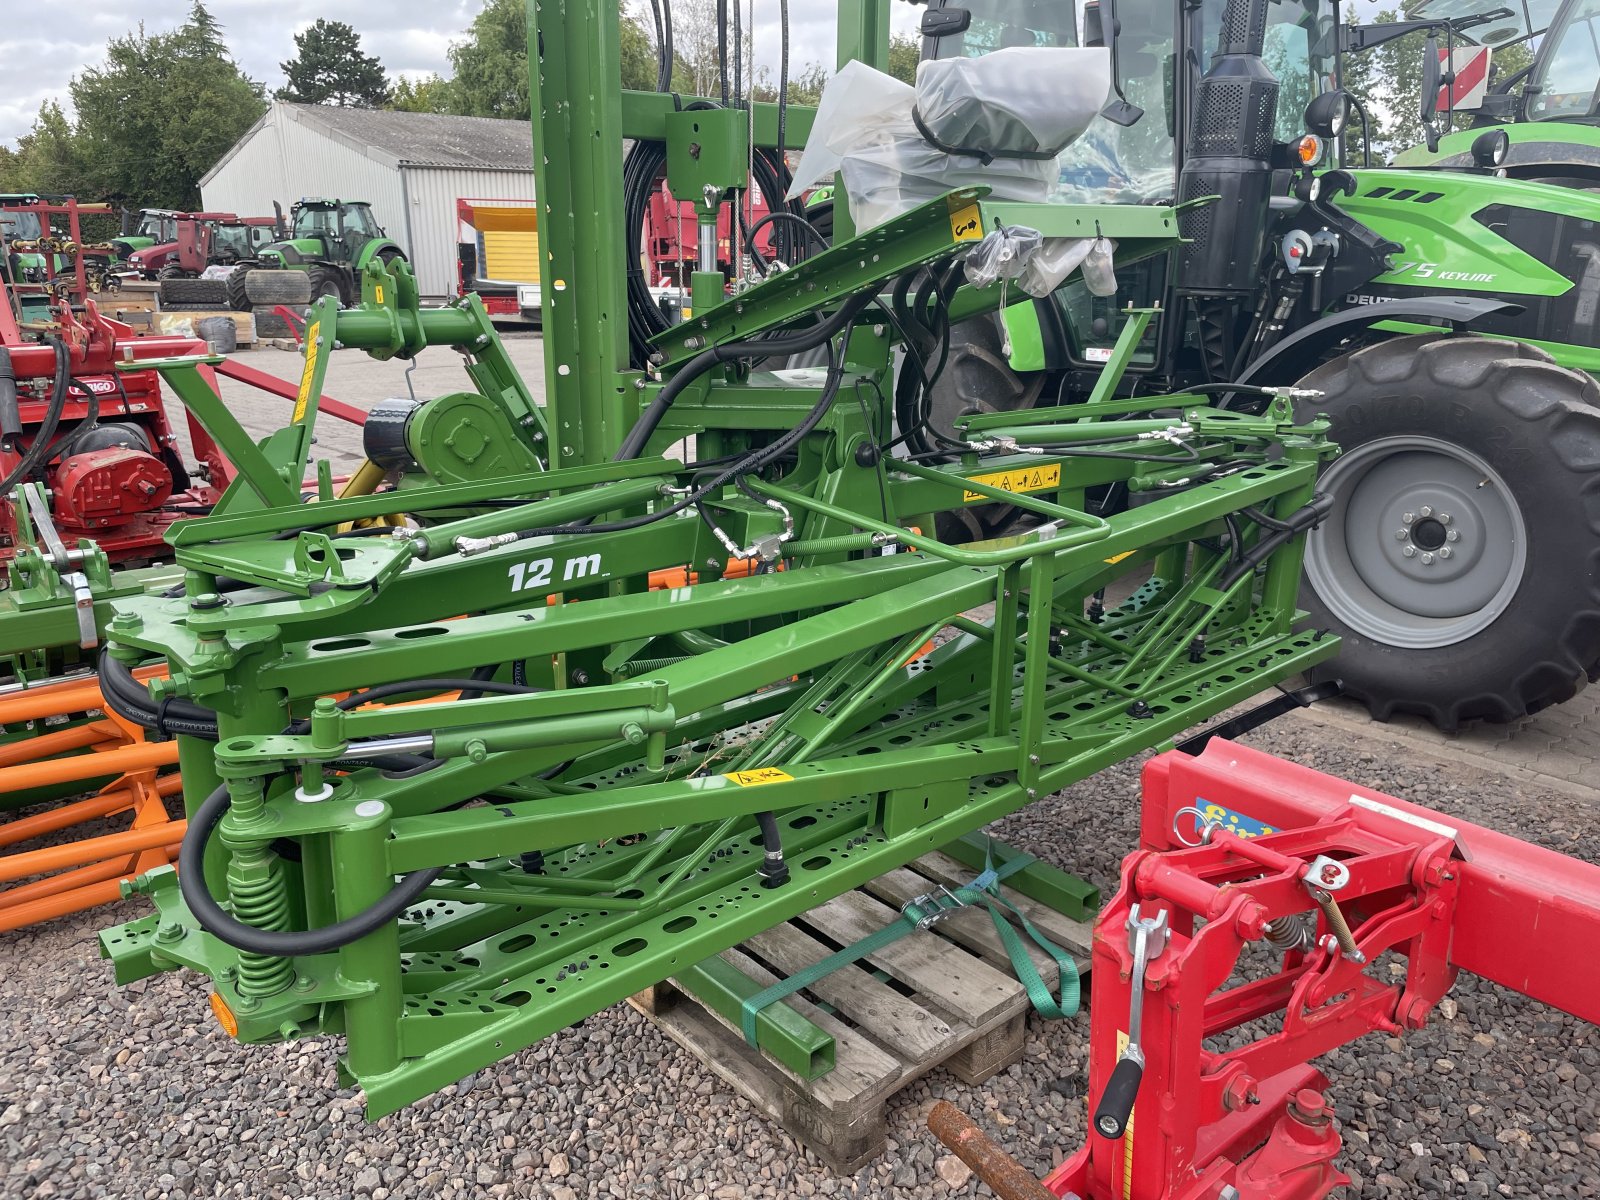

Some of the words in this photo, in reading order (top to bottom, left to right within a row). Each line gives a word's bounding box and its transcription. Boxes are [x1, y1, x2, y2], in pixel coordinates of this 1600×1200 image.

[1437, 271, 1496, 283] KEYLINE
[508, 557, 554, 592] 12
[563, 553, 602, 581] m
